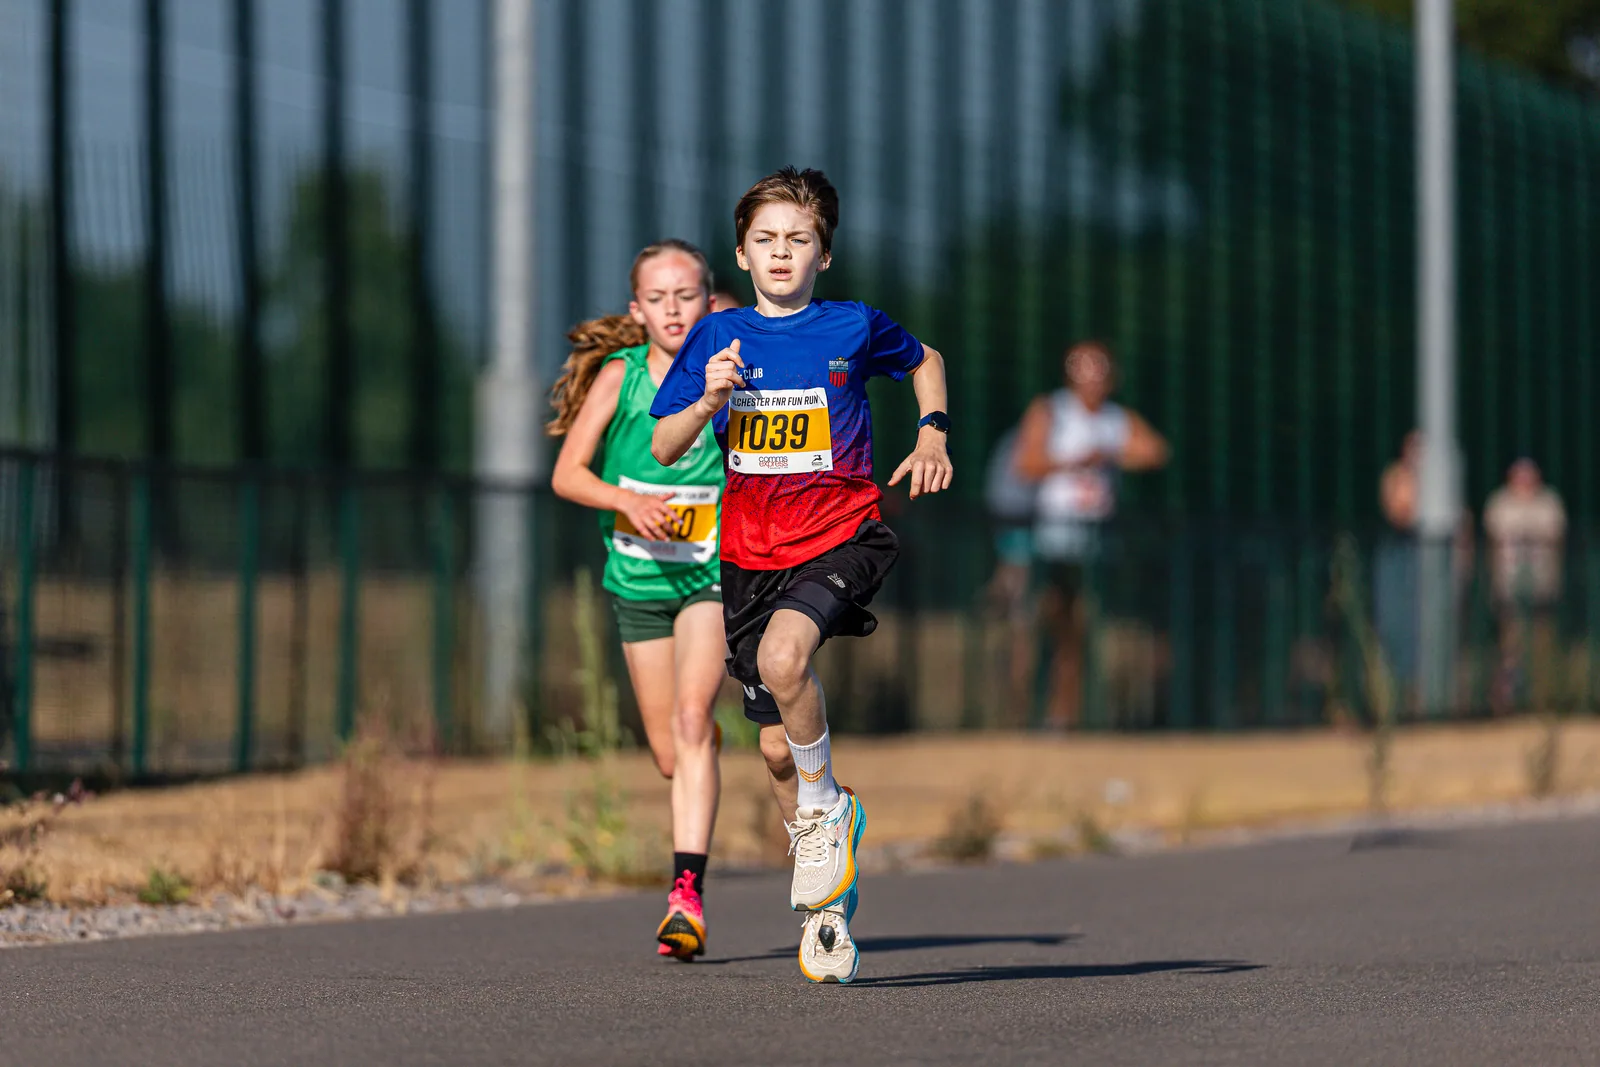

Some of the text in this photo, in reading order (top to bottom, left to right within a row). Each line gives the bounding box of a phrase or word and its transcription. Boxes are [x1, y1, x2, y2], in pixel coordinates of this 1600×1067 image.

[743, 368, 764, 380] CLUB
[732, 394, 819, 407] LCHESTER FNR FUN RUN
[739, 413, 810, 451] 1039
